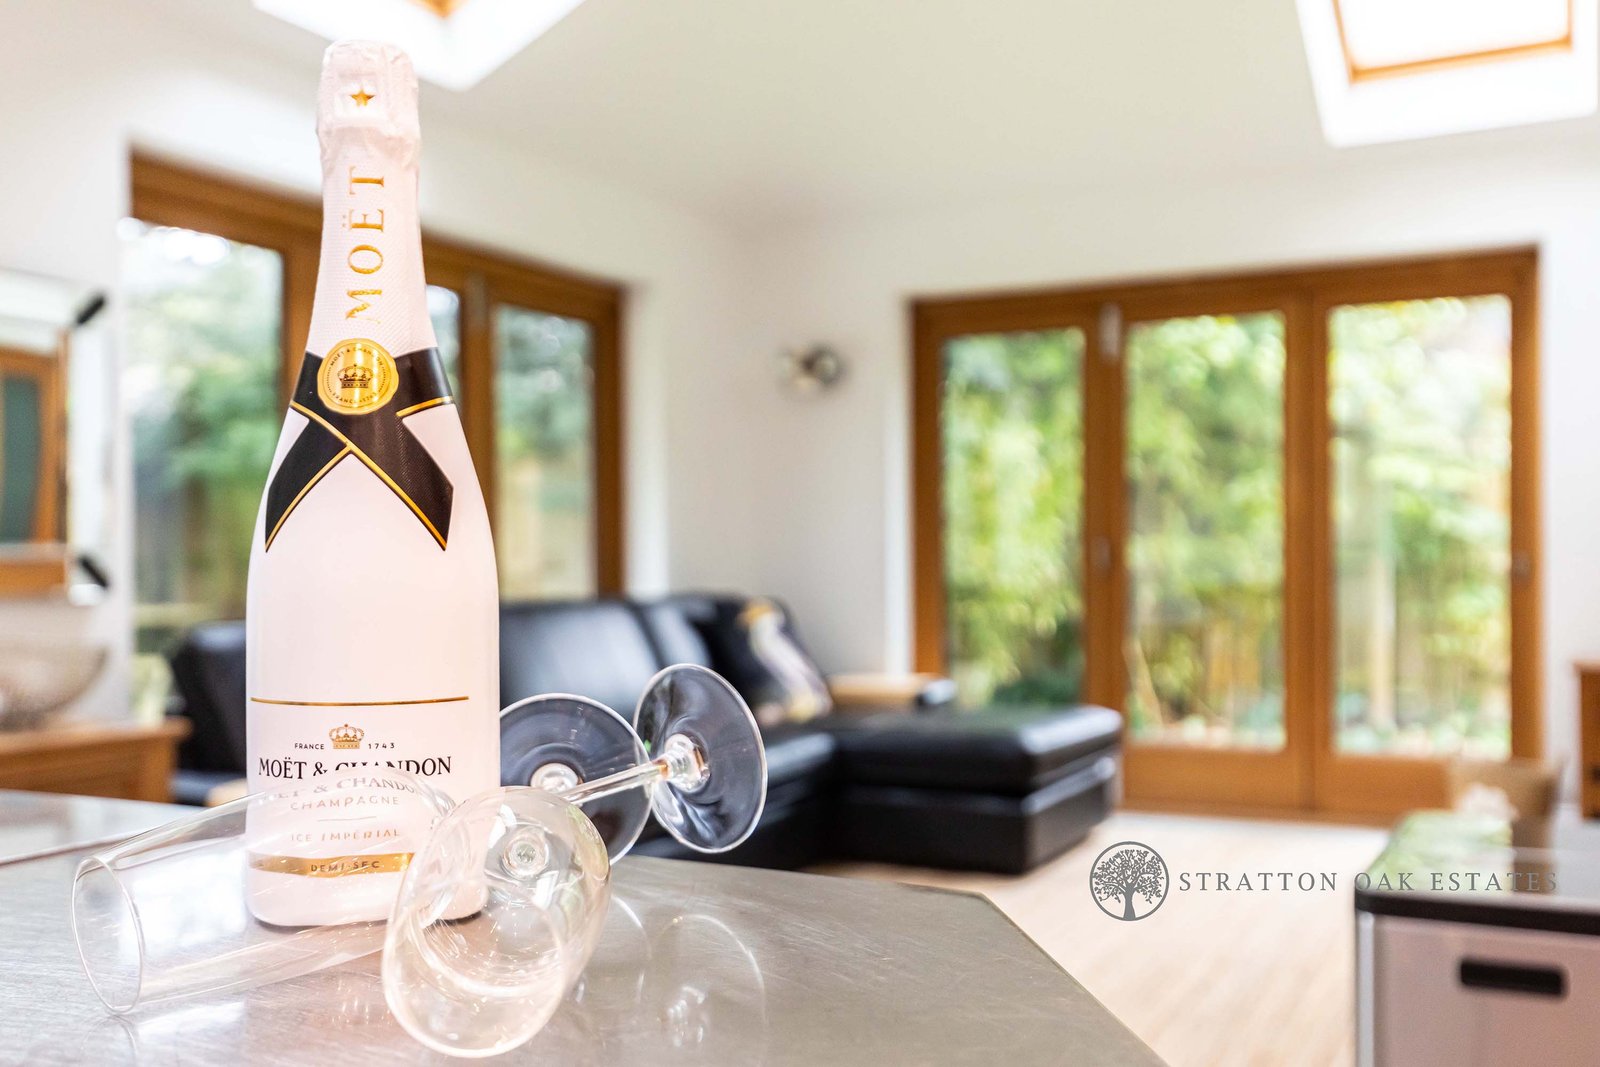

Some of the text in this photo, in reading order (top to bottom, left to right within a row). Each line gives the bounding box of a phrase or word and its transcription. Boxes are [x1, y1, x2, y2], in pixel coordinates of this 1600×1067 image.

[342, 166, 385, 324] MOËT
[294, 742, 324, 750] FRANCE
[258, 756, 451, 779] MOËT & CNDON
[290, 795, 399, 810] CHAMPAGNE
